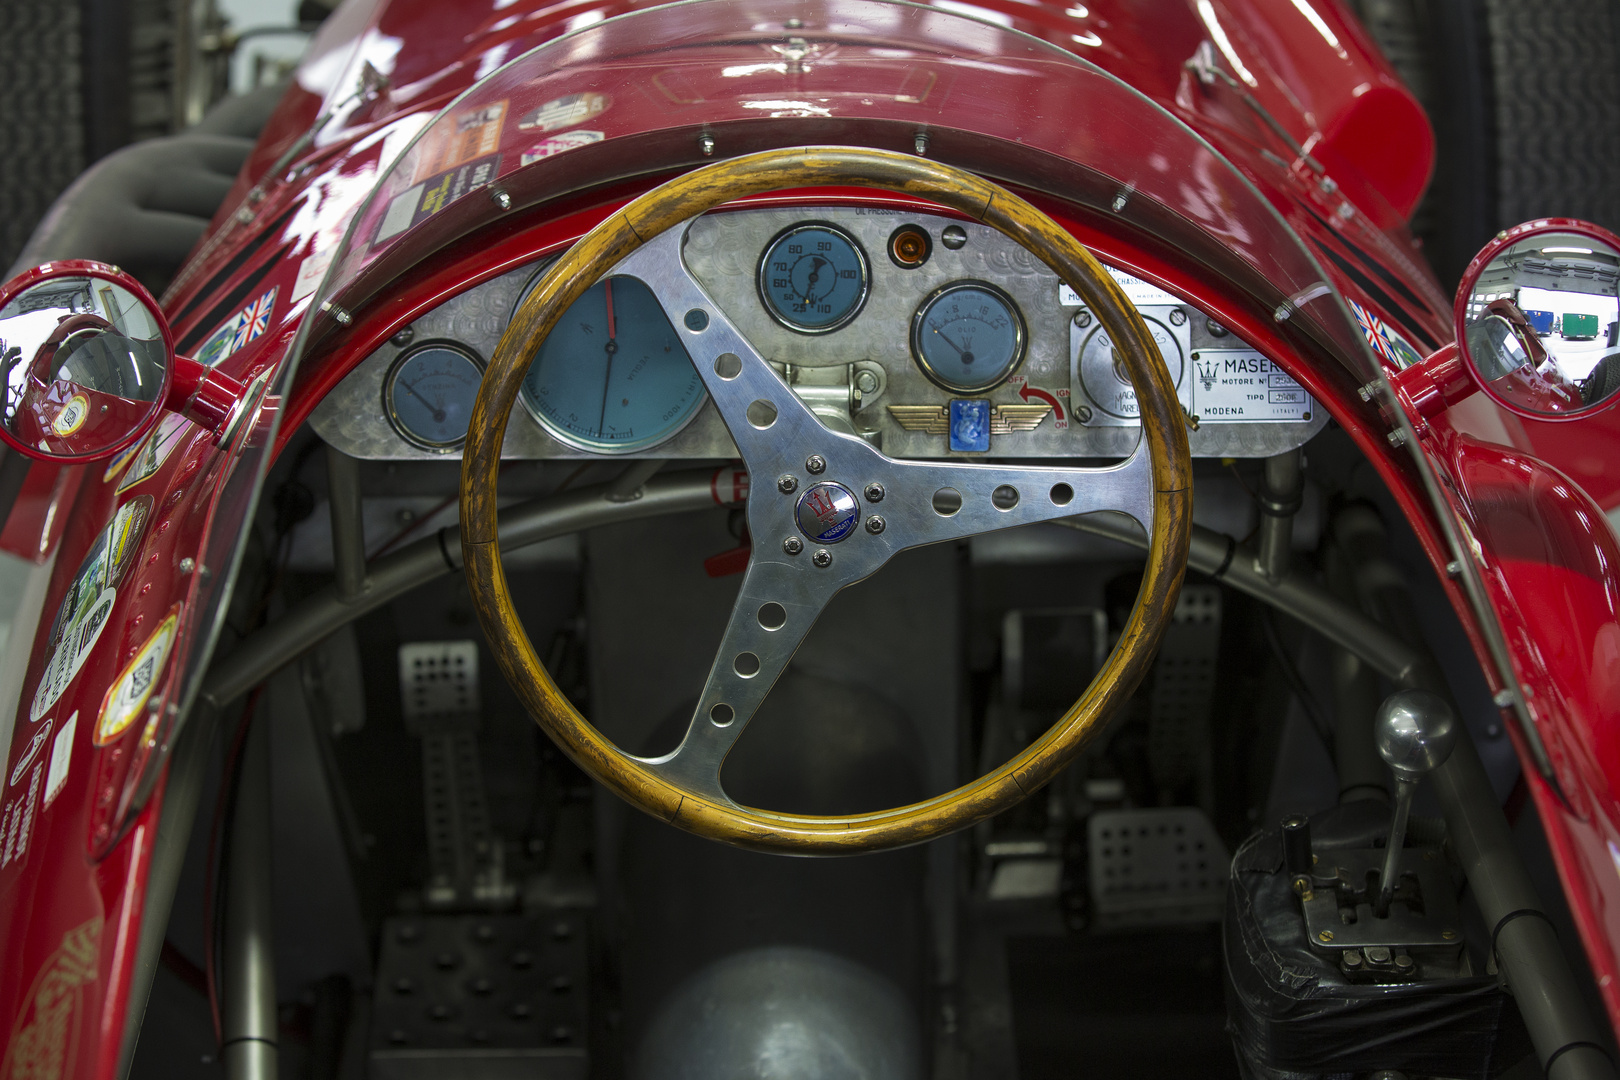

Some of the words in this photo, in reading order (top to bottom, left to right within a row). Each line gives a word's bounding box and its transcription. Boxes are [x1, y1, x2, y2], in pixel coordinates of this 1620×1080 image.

[788, 245, 803, 254] 80
[817, 242, 832, 251] 90
[773, 262, 787, 271] 70
[840, 270, 856, 279] 100
[773, 279, 787, 288] 60
[792, 303, 807, 313] 25
[817, 304, 831, 313] 110
[951, 304, 960, 313] 8
[979, 304, 990, 315] 16
[995, 314, 1009, 328] 22
[1097, 334, 1109, 347] 0
[417, 362, 424, 372] 2
[627, 354, 650, 381] VEGLIA
[1007, 376, 1025, 384] OFF
[540, 386, 550, 396] 3
[1056, 390, 1070, 398] IGN
[663, 404, 682, 422] 1000
[1204, 407, 1244, 415] MODENA
[568, 412, 578, 422] 2
[1054, 421, 1068, 429] ON
[823, 520, 851, 539] MASERATI
